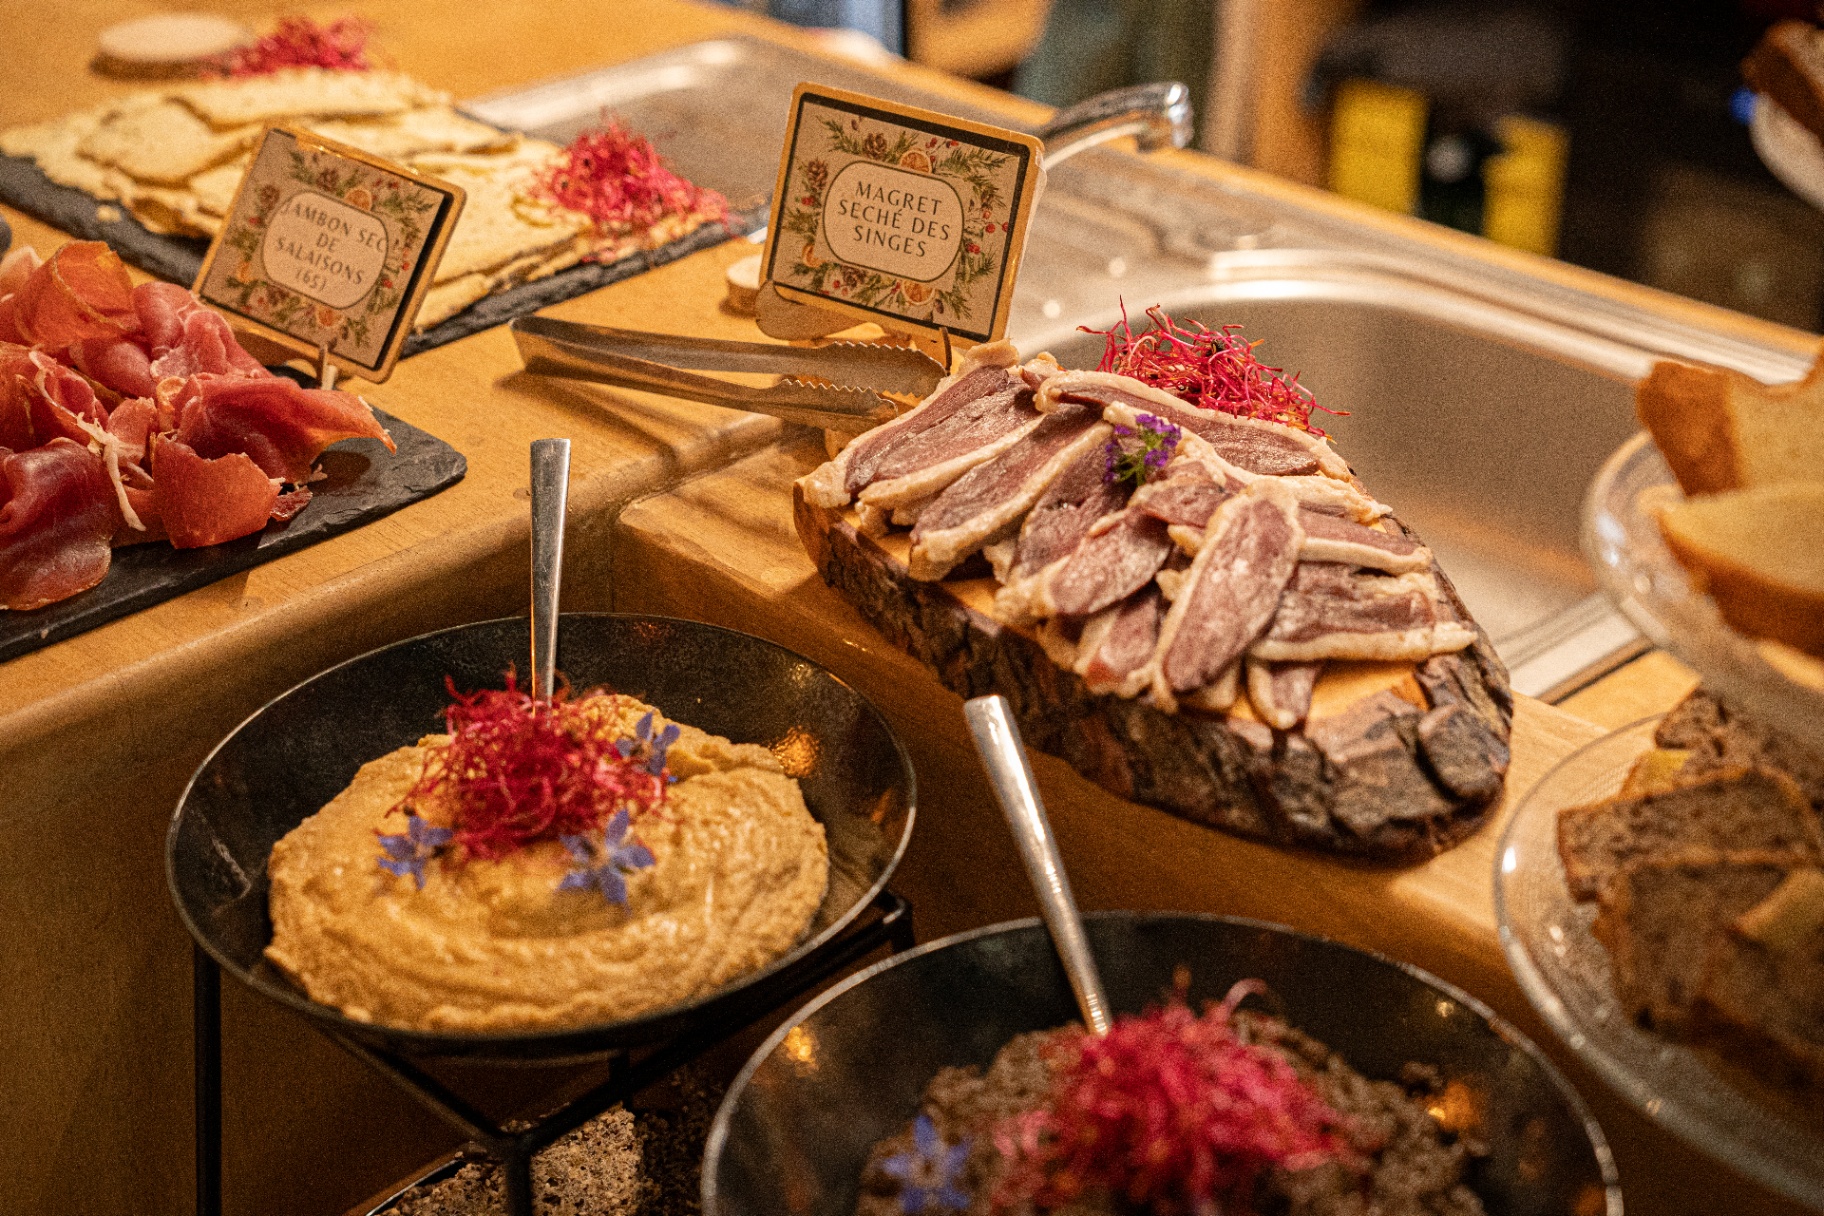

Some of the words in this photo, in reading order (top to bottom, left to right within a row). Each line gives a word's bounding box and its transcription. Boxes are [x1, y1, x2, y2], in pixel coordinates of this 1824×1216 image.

[855, 181, 942, 215] MAGRET
[316, 232, 340, 253] DE
[358, 228, 386, 253] SEC
[854, 225, 927, 257] SINGES
[911, 217, 950, 241] DES
[276, 236, 365, 285] SALAISONS
